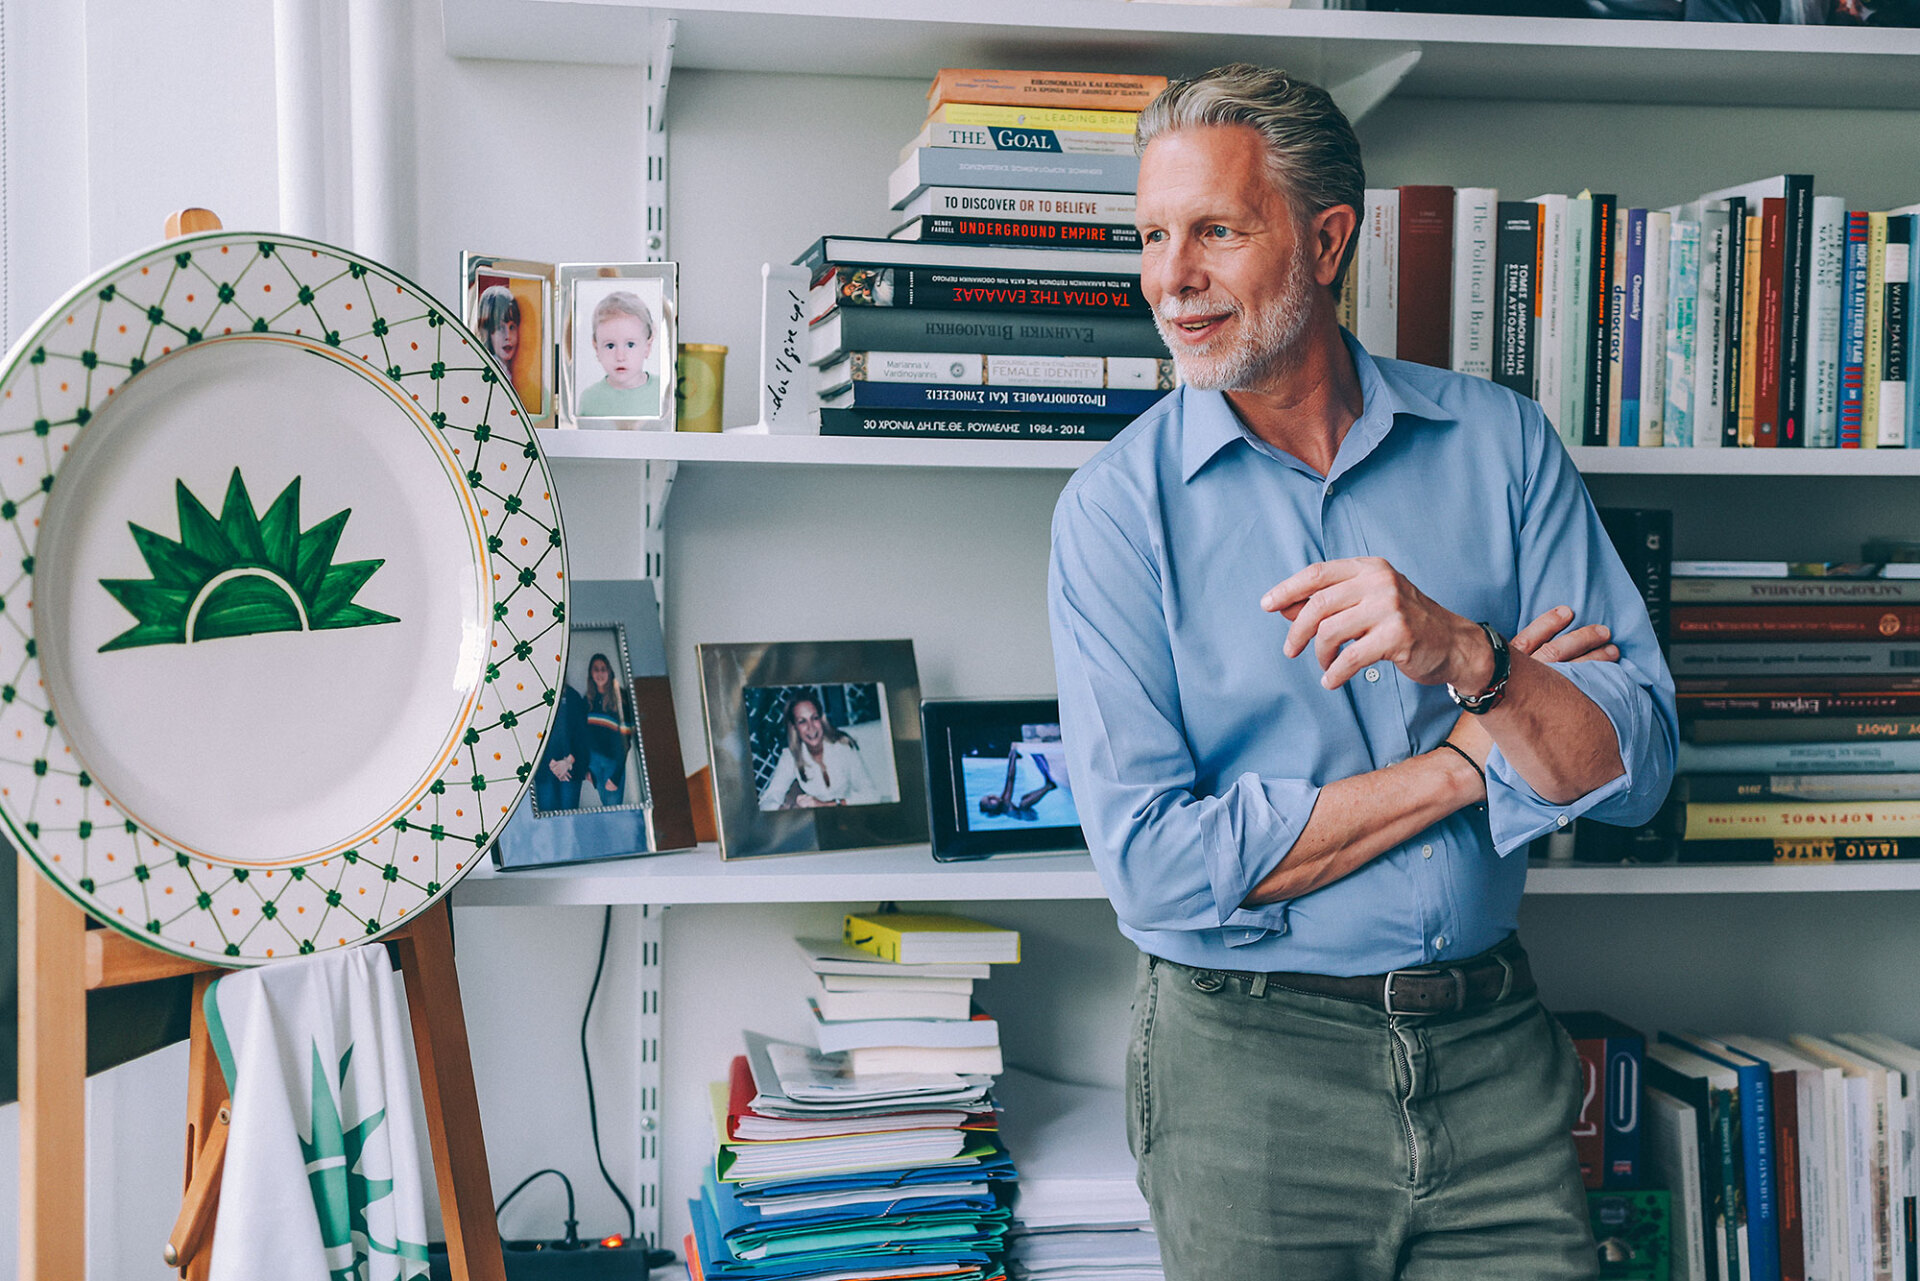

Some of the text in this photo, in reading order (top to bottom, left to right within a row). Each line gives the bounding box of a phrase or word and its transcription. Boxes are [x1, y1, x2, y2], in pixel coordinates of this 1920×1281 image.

[1089, 80, 1103, 88] ΚΑΙ
[1045, 114, 1097, 124] LEADING
[949, 130, 987, 145] THE
[998, 130, 1051, 149] GOAL
[944, 196, 1097, 214] TO DISCOVER OR TO BELIEVE
[931, 226, 955, 234] FARRELL
[959, 221, 1106, 241] UNDERGROUND EMPIRE
[1714, 228, 1723, 304] TRANSPARENCY
[1817, 226, 1827, 286] NATIONS
[1468, 202, 1487, 352] The Political Brain
[1629, 220, 1642, 321] SMITH Chomsky
[1874, 249, 1882, 295] POLITICS
[788, 289, 805, 322] up!
[952, 288, 1131, 307] ΤΑ ΟΠΛΑ ΤΗΣ ΕΛΛΑΔΑΣ
[1852, 244, 1867, 364] HOPE IS A TATTERED FLAG
[1873, 300, 1879, 312] OF
[1506, 264, 1518, 376] ΣΤΗΝ ΑΥΤΟΔΙΟΙΚΗΣΗ
[1516, 264, 1529, 376] ΤΟΜΕΣ ΔΗΜΟΚΡΑΤΙΑΣ
[1714, 306, 1720, 318] IN
[926, 322, 1094, 342] ΕΛΛΗΝΙΚΗ ΒΙΒΛΙΟΘΗΚΗ
[1610, 285, 1626, 364] democracy
[1890, 284, 1902, 381] WHAT MAKES US
[1712, 318, 1720, 366] POSTWAR
[884, 370, 938, 379] Vardinoyannis
[887, 360, 922, 369] Marianna
[992, 366, 1098, 379] FEMALE IDENTITY
[1817, 360, 1826, 415] SHARMA
[1868, 363, 1876, 422] EDUCATION
[925, 389, 1106, 407] ΠΡΟΣΩΠΟΓΡΑΦΙΕΣ ΚΑΙ ΣΥΝΘΕΣΕΙΣ
[863, 420, 876, 430] 30
[878, 420, 915, 431] ΧΡΟΝΙΑ
[968, 422, 1020, 433] ΡΟΥΜΕΛΗΣ
[1029, 424, 1052, 434] 1984
[1060, 424, 1085, 434] 2014
[1750, 584, 1902, 597] ΝΑΓΚΟΡΝΟ ΚΑΡΑΜΠΑΧ
[1782, 813, 1874, 824] ΚΟΡΙΝΘΟΣ
[1774, 843, 1898, 858] ΙΔΑΙΟ ΑΝΤΡΟ
[1756, 1081, 1770, 1218] RUTH BADER GINSBURG
